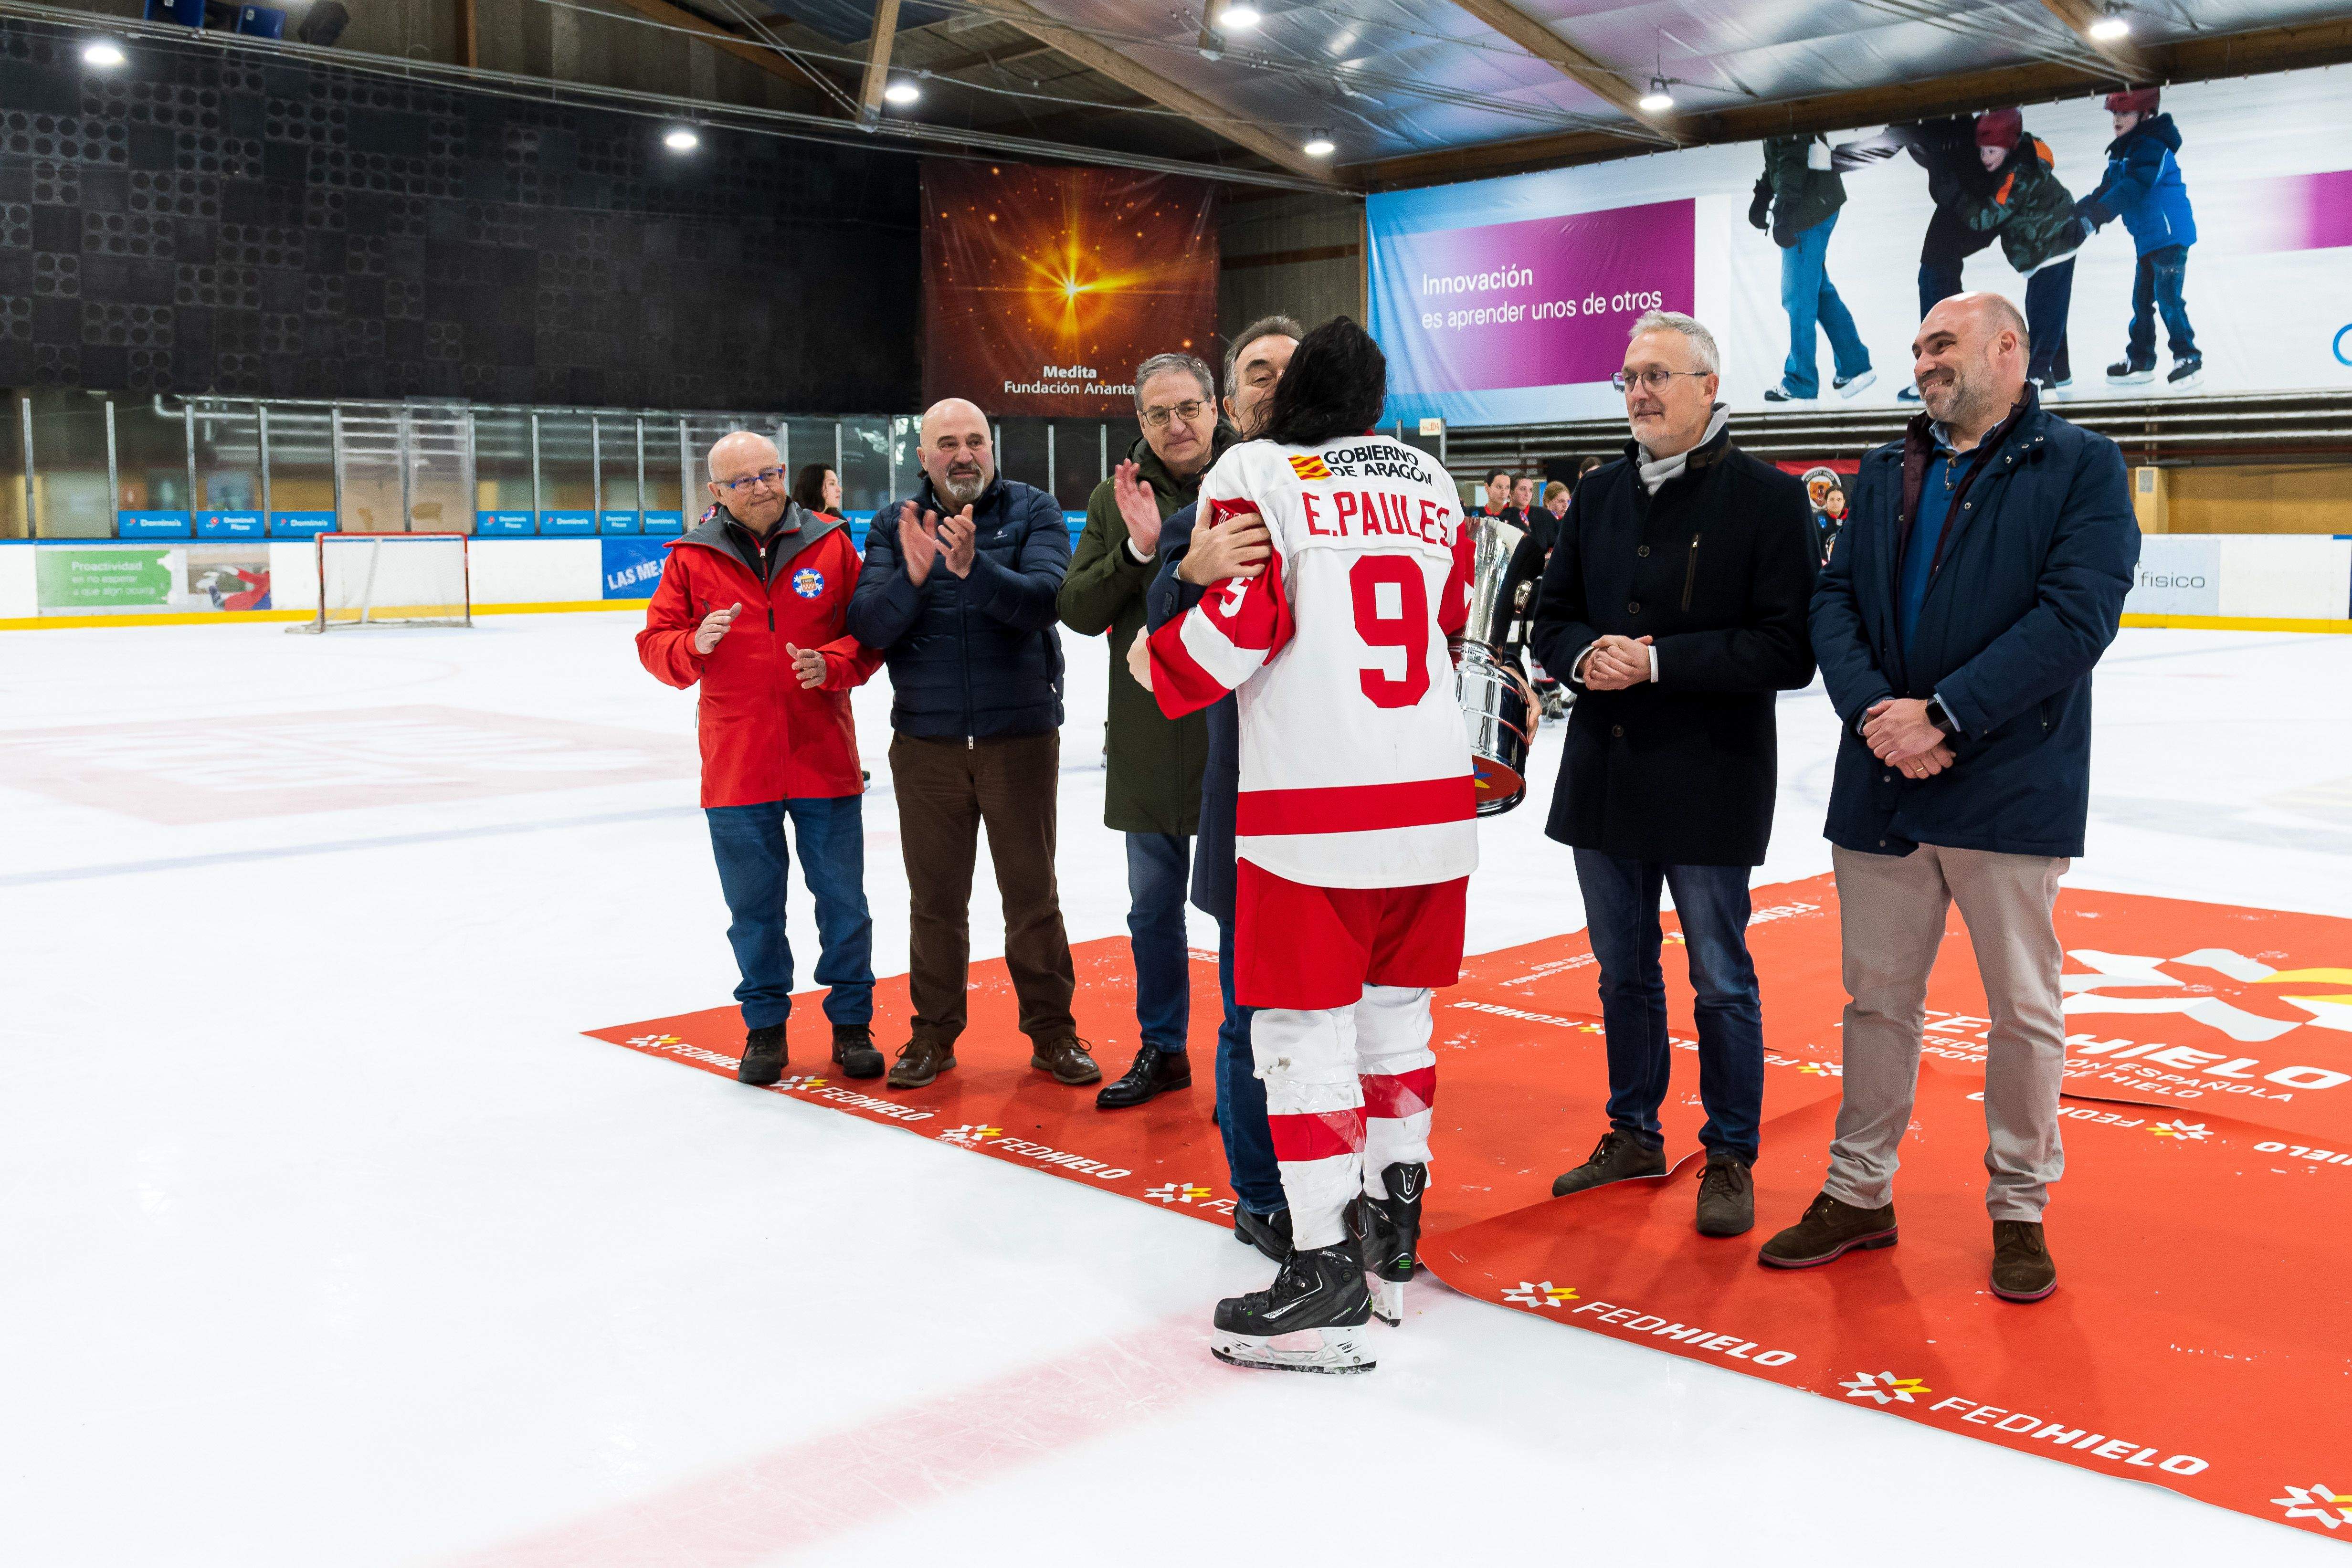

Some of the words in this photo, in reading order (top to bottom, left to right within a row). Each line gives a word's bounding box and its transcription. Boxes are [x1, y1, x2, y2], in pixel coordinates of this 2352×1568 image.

[1422, 263, 1533, 295] Innovación
[1421, 311, 1442, 329] es
[1448, 300, 1527, 331] aprender
[1531, 299, 1576, 320] unos
[1582, 293, 1606, 315] de
[1612, 289, 1663, 312] otros
[1004, 380, 1079, 394] Fundación
[1084, 382, 1136, 395] Ananta
[1043, 365, 1097, 379] Medita
[1324, 445, 1418, 466] GOBIERNO
[1329, 465, 1358, 477] DE
[1364, 463, 1433, 487] ARAGON
[1302, 491, 1450, 548] E.PAULES
[72, 561, 143, 571] Proactividad
[607, 568, 636, 590] LAS
[636, 558, 665, 581] MEJ
[1349, 555, 1431, 709] 9
[2099, 1071, 2204, 1098] HIELO
[2114, 1063, 2294, 1102] ESPAÑOLA
[810, 1087, 934, 1121] FEDHIELO
[987, 1137, 1132, 1179] FEDHIELO
[2253, 1141, 2352, 1166] IELO
[1572, 1301, 1798, 1367] FEDHIELO
[1929, 1396, 2210, 1475] FEDHIELO
